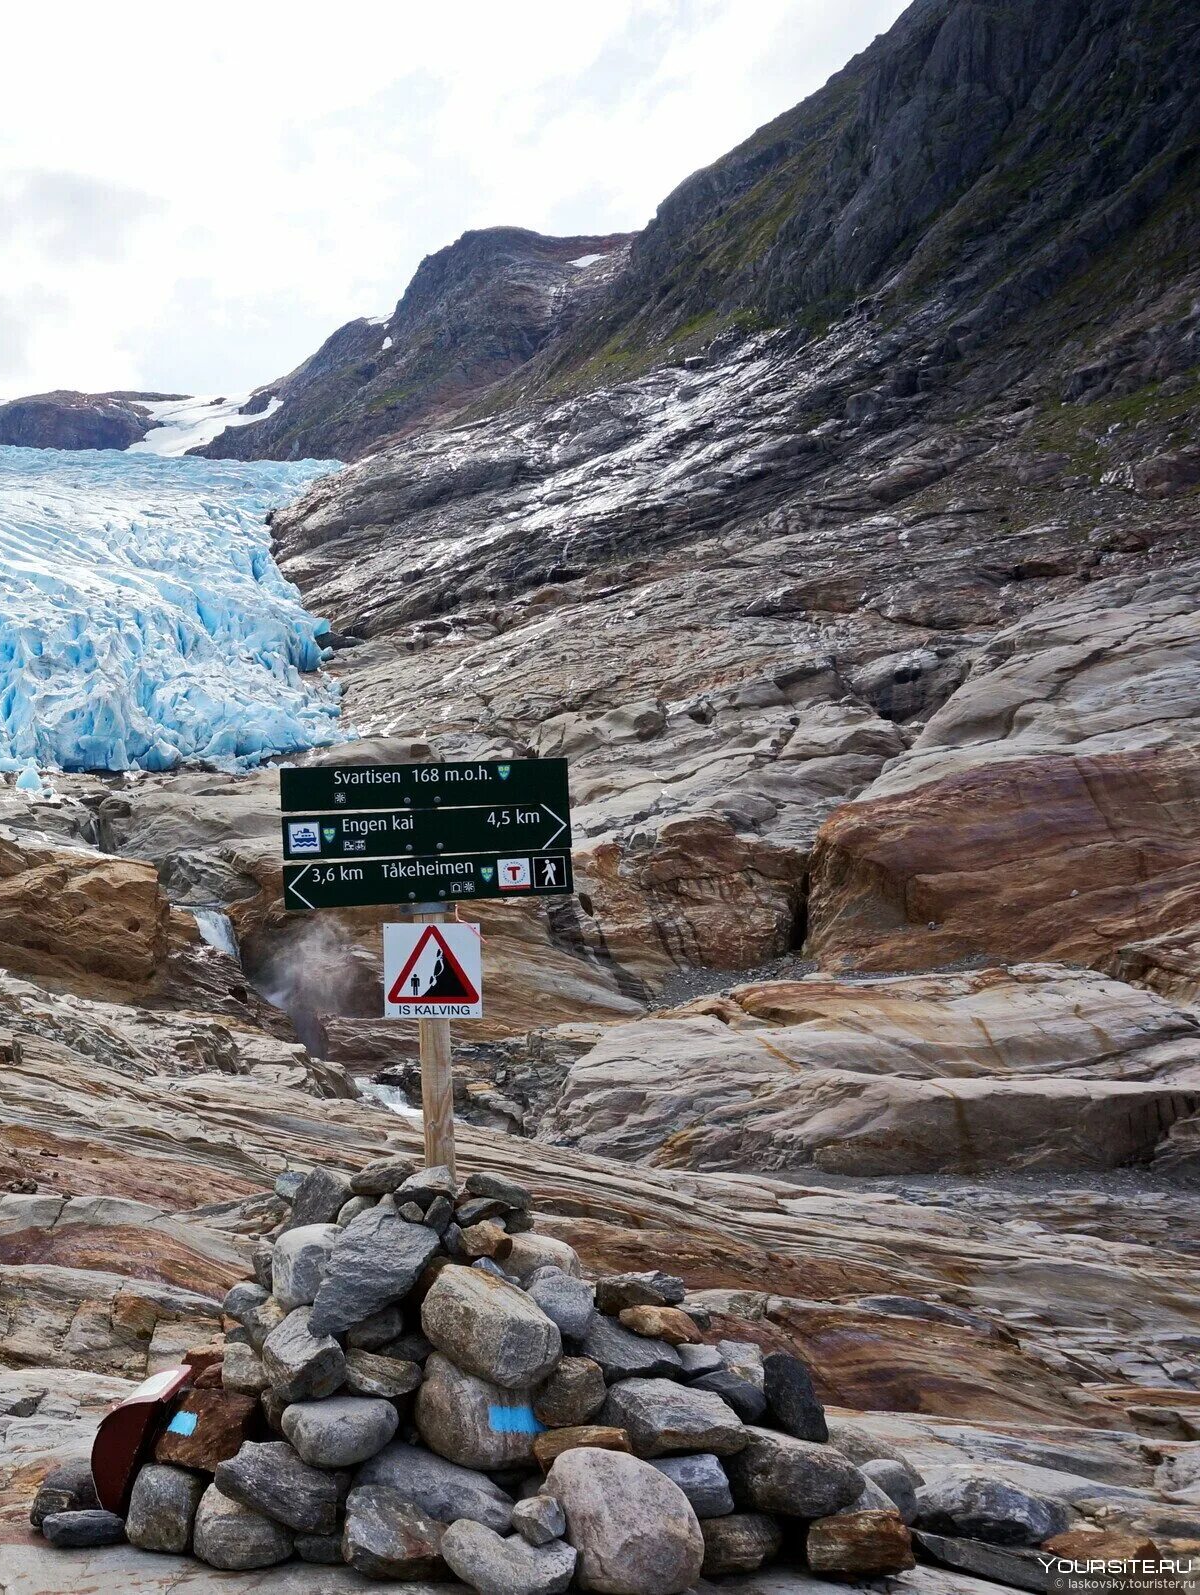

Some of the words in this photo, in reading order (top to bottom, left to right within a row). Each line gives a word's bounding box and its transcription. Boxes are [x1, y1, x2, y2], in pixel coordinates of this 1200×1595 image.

[334, 769, 401, 785] Svartisen
[412, 769, 439, 783] 168
[445, 766, 492, 782] m.o.h.
[342, 818, 388, 835] Engen
[392, 815, 414, 831] kai
[487, 811, 510, 827] 4,5
[516, 809, 540, 824] km
[312, 867, 334, 883] 3,6
[339, 866, 363, 881] km
[381, 861, 474, 878] Tåkeheimen
[399, 1005, 410, 1015] IS
[415, 1005, 470, 1015] KALVING
